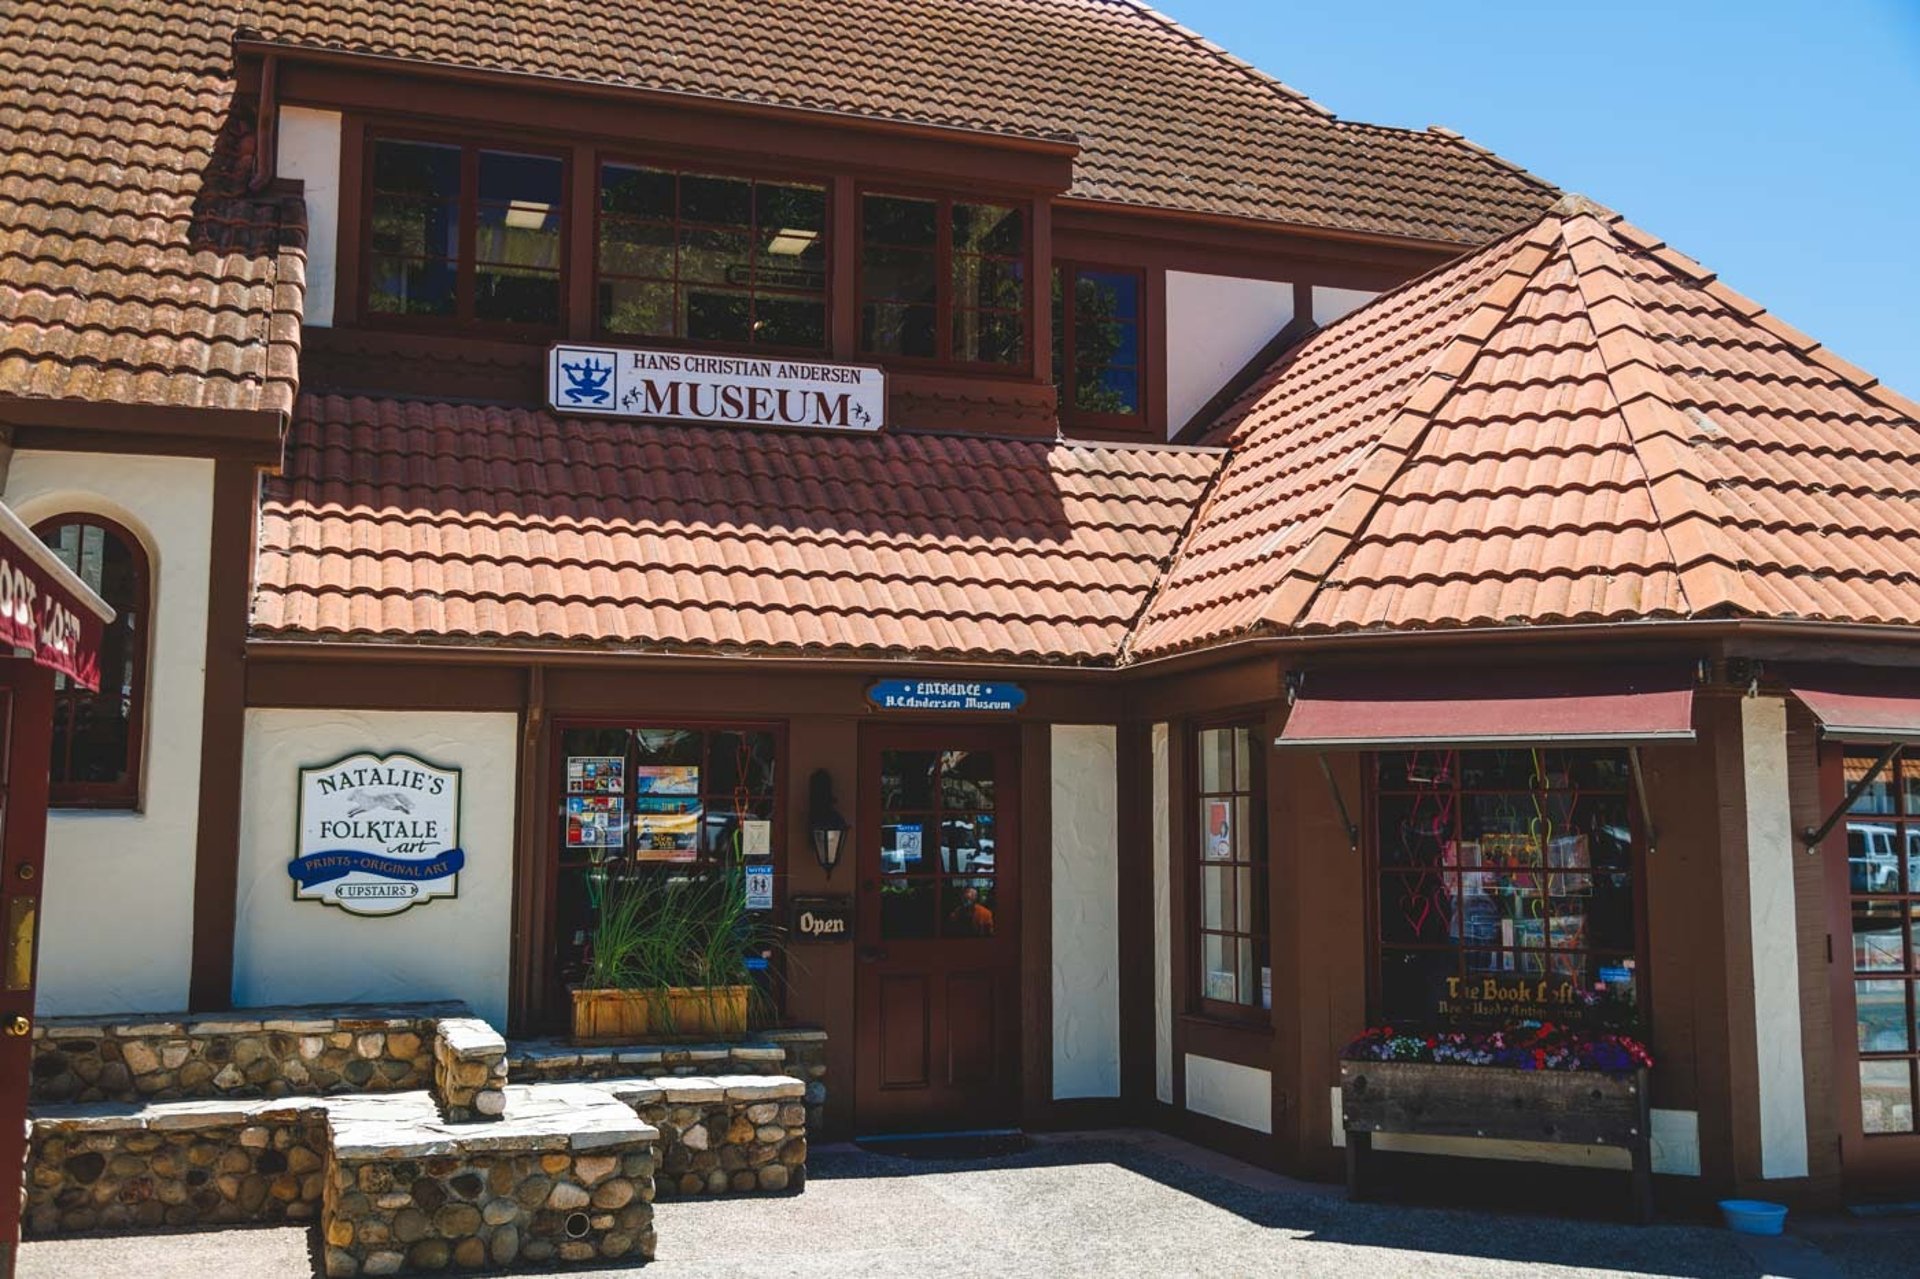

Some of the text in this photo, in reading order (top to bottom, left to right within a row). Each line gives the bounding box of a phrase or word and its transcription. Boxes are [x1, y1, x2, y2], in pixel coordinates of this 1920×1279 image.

[633, 353, 862, 384] HANS CHRISTIAN ANDERSEN
[640, 379, 852, 427] MUSEUM
[916, 682, 981, 696] ENTRANCE
[965, 697, 1011, 710] Museum
[317, 768, 445, 796] NATALIE'S
[320, 820, 438, 843] FOLKTALE
[387, 839, 441, 854] art
[305, 856, 449, 877] PRINTS ORIGINAL ART
[347, 885, 407, 897] UPSTAIRS
[800, 911, 845, 936] Open
[1482, 978, 1532, 1002] Book
